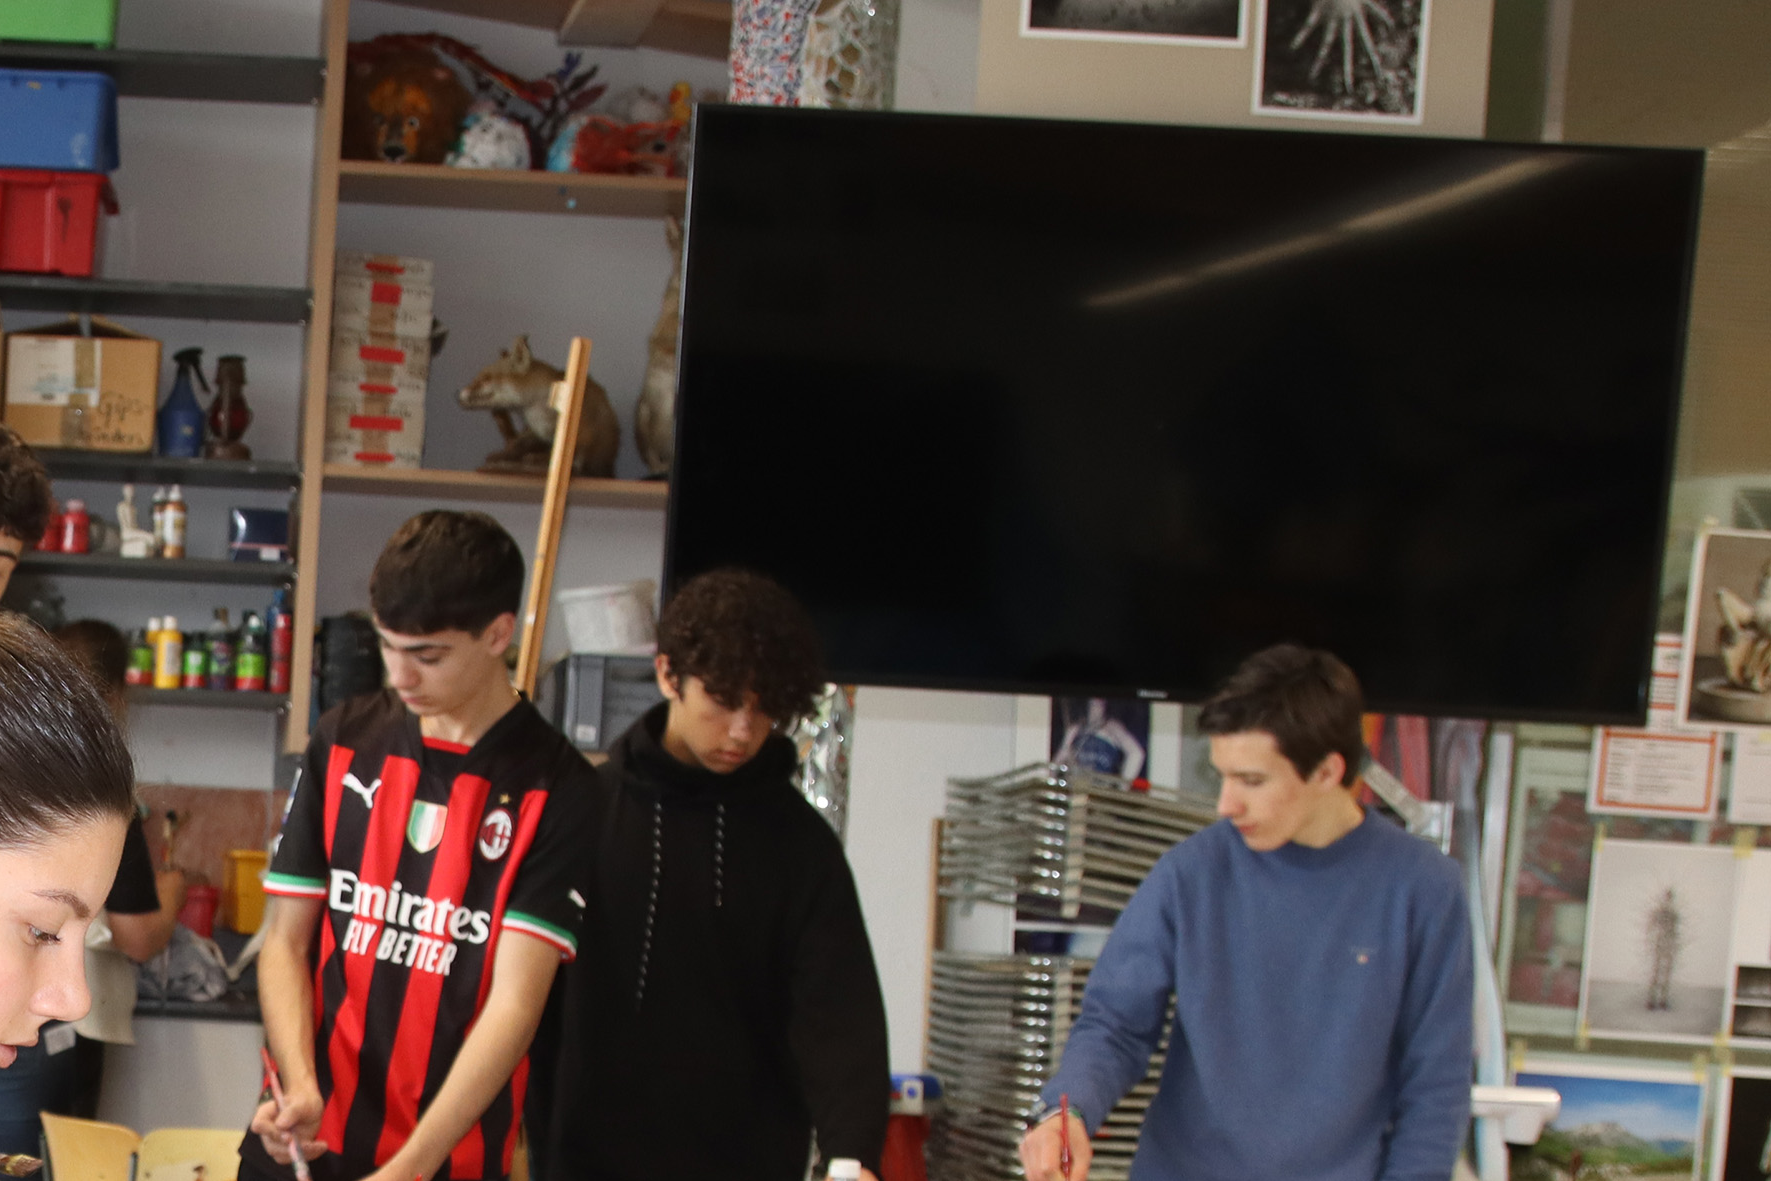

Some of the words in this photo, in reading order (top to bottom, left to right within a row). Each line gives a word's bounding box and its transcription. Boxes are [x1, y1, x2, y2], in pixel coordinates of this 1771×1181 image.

[329, 868, 491, 944] Emirates
[342, 917, 377, 956] FLY
[375, 927, 458, 976] BETTER
